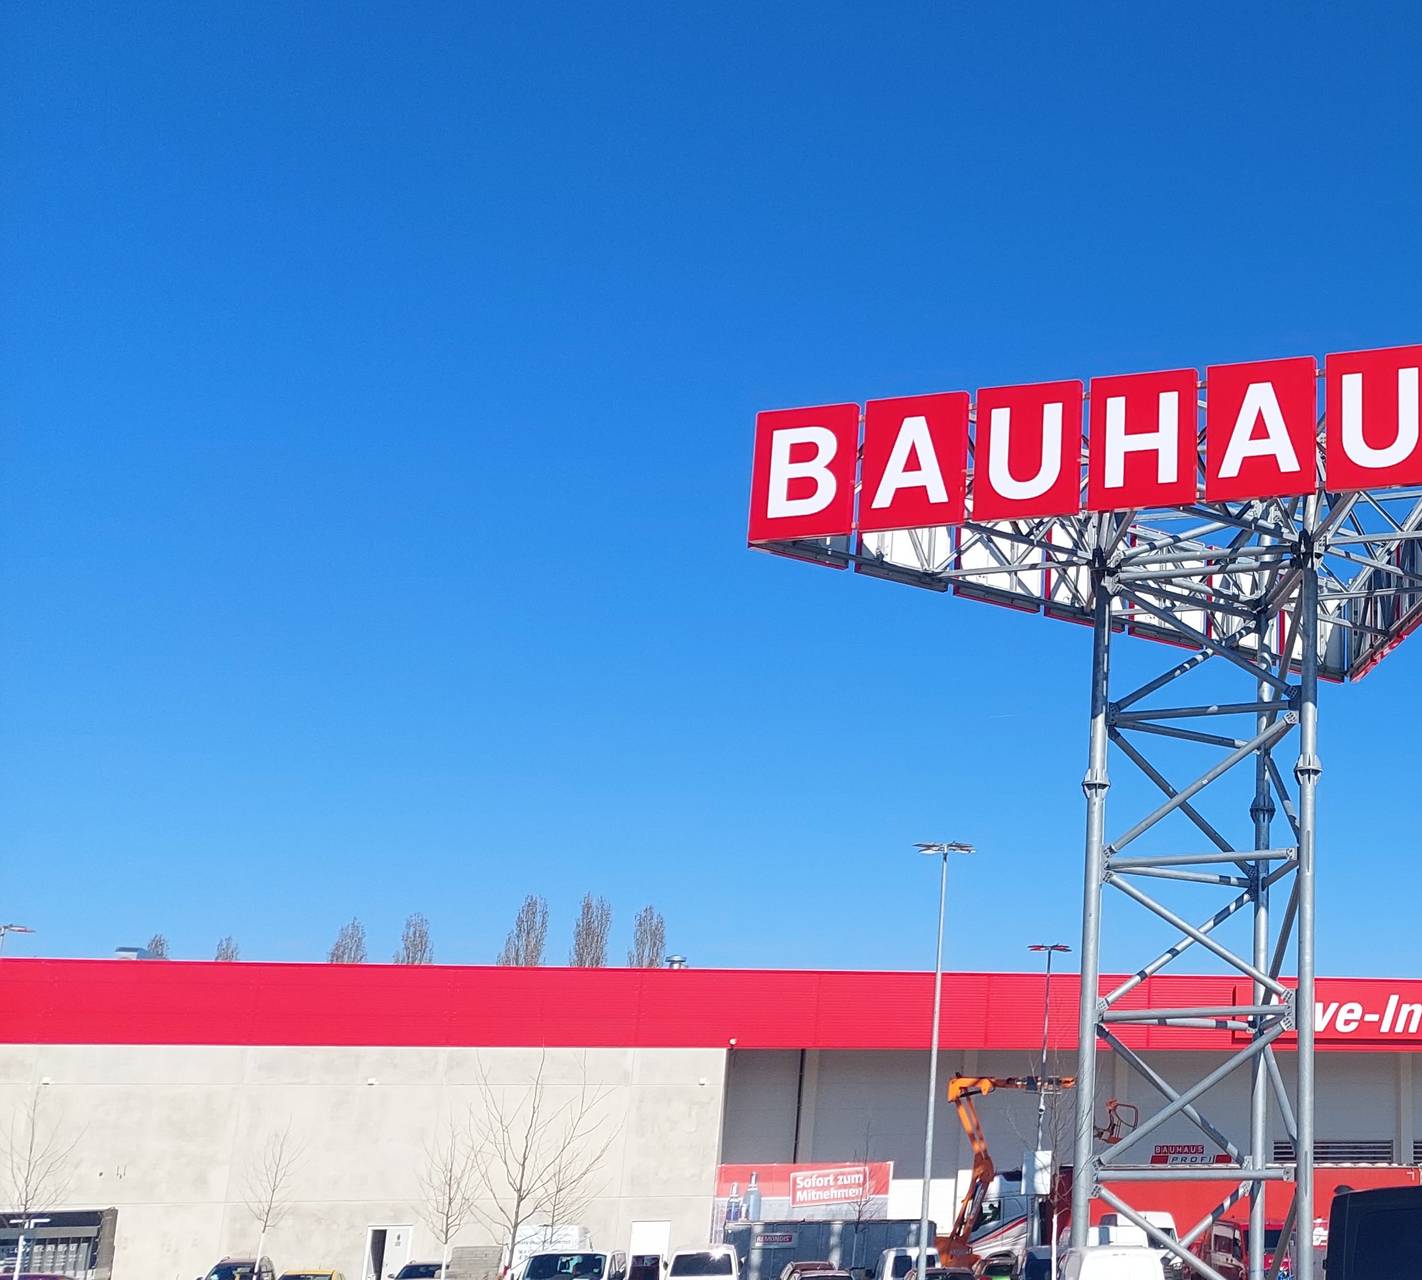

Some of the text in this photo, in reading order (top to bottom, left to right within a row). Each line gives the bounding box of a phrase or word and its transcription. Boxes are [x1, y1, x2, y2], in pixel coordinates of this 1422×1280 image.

[1155, 1145, 1204, 1154] BAUHAUS
[1171, 1156, 1212, 1164] PROFI
[796, 1173, 863, 1189] Sofort zum
[796, 1187, 862, 1202] Mitnehmen
